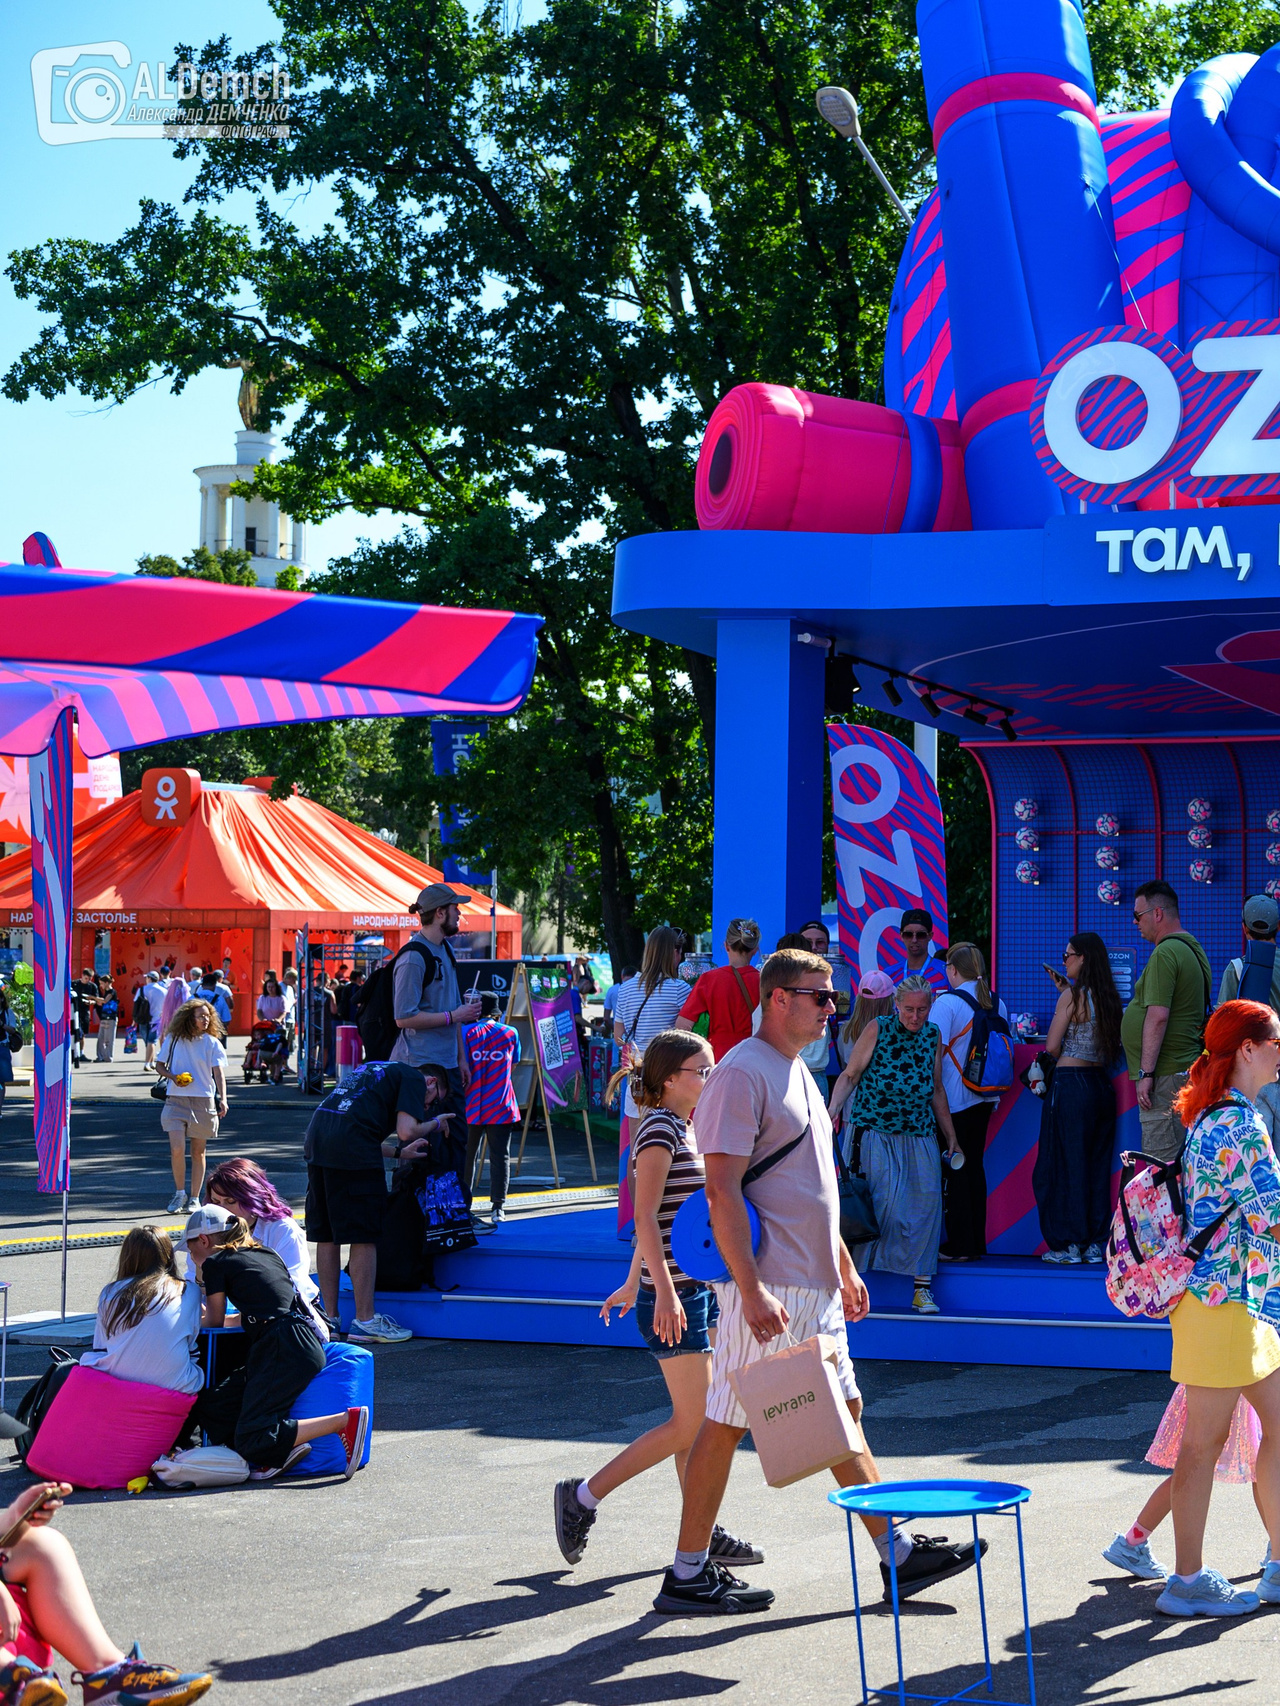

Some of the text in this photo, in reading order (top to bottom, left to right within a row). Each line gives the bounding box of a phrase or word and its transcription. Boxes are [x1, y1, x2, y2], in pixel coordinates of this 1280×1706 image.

[1096, 527, 1254, 581] там,
[76, 912, 137, 924] ЗАСТОЛЬЕ
[353, 914, 420, 928] НАРОДНЫЙ ДЕНЬ
[472, 1050, 512, 1061] OZON
[763, 1390, 816, 1422] levrana
